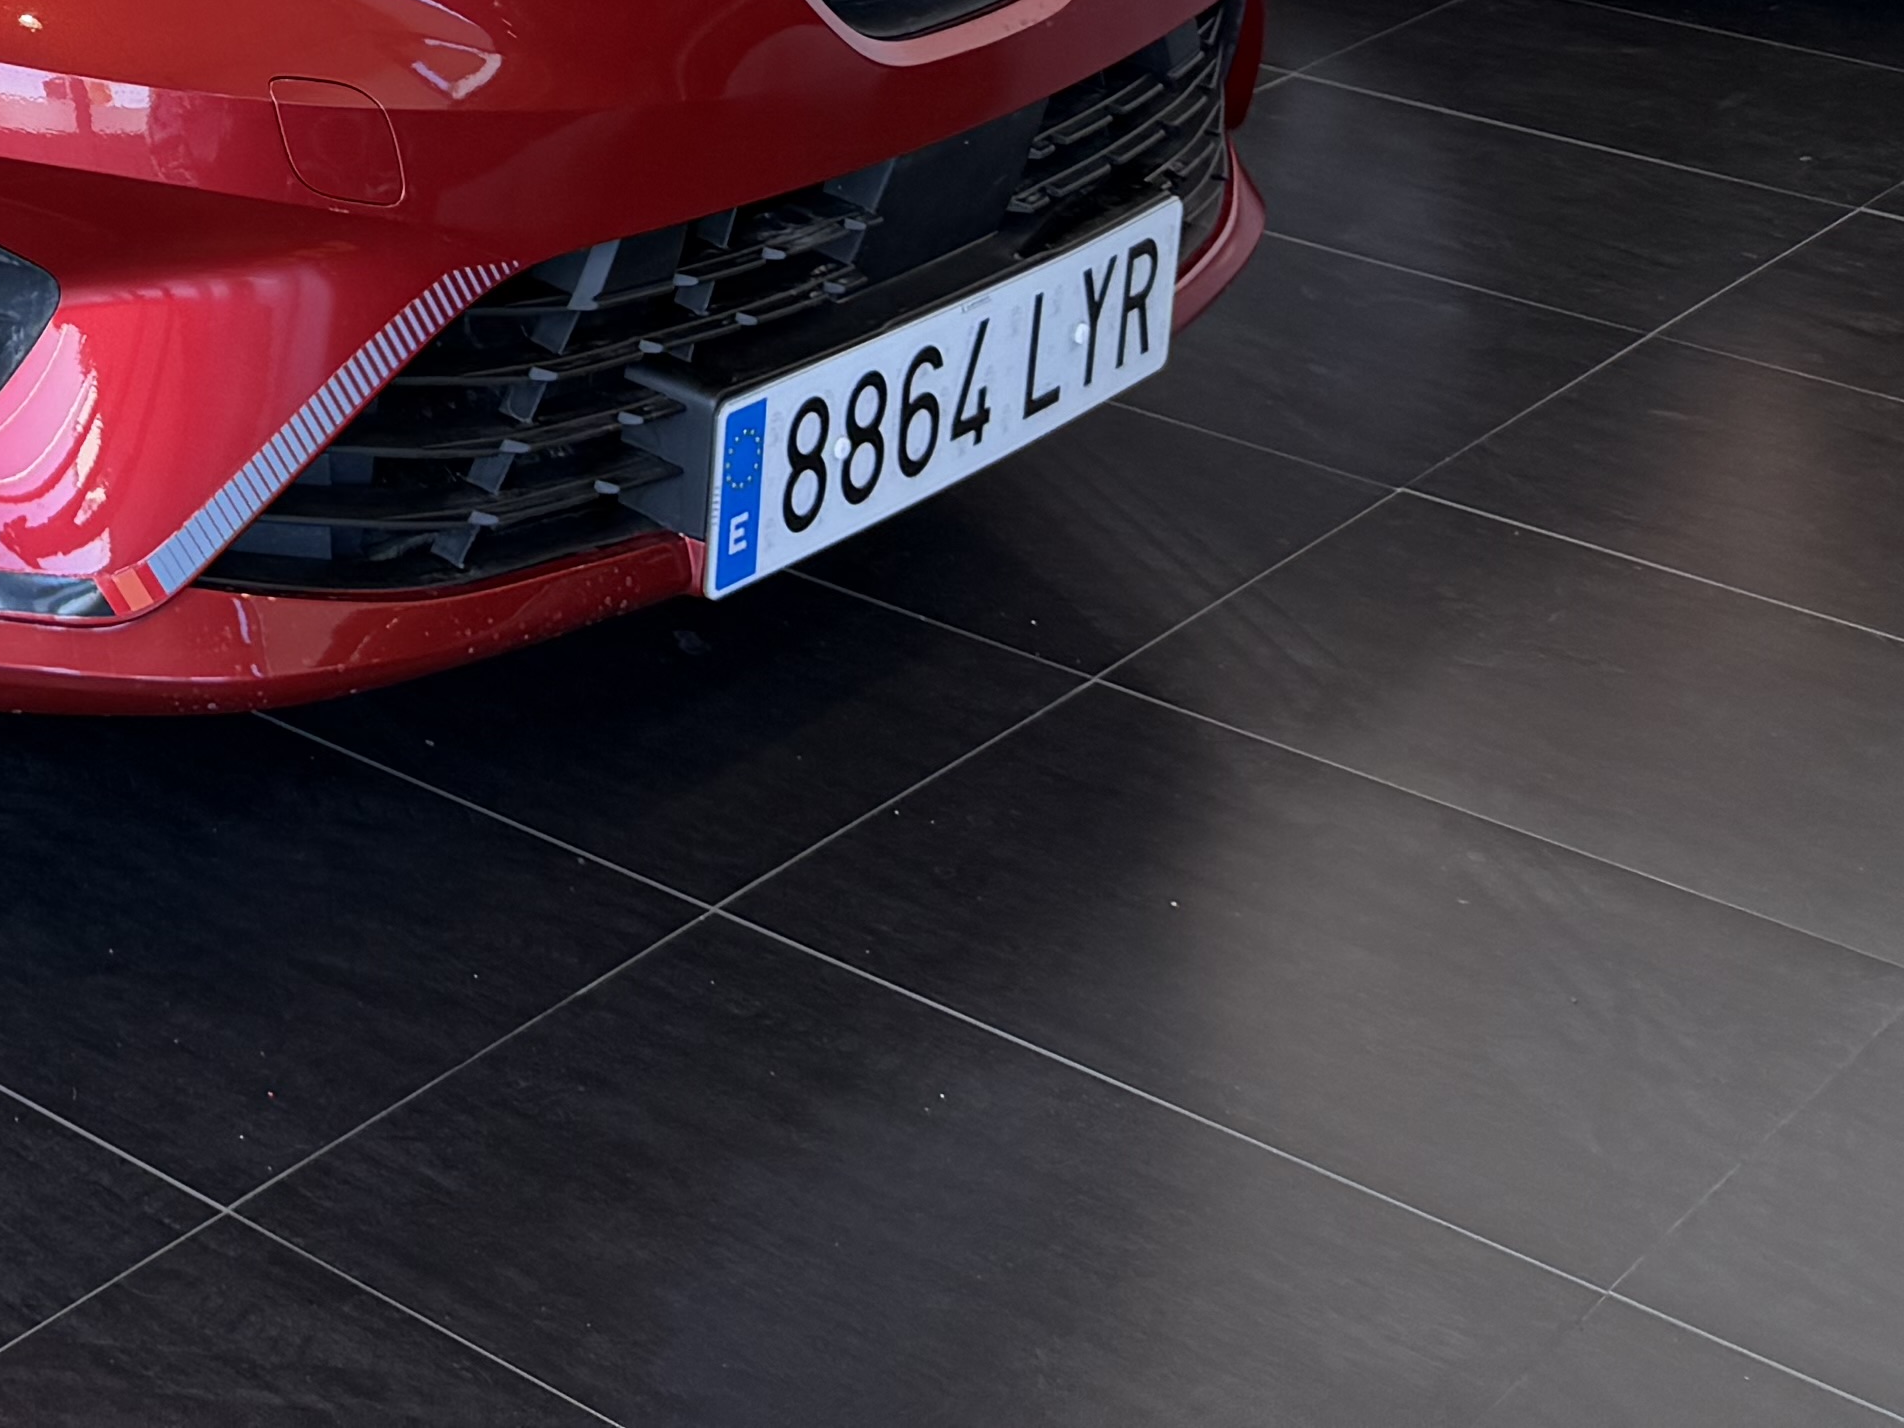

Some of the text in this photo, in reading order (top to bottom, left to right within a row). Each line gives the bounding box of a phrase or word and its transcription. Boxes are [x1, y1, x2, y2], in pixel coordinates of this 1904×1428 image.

[729, 237, 1158, 554] E 8864 LYR
